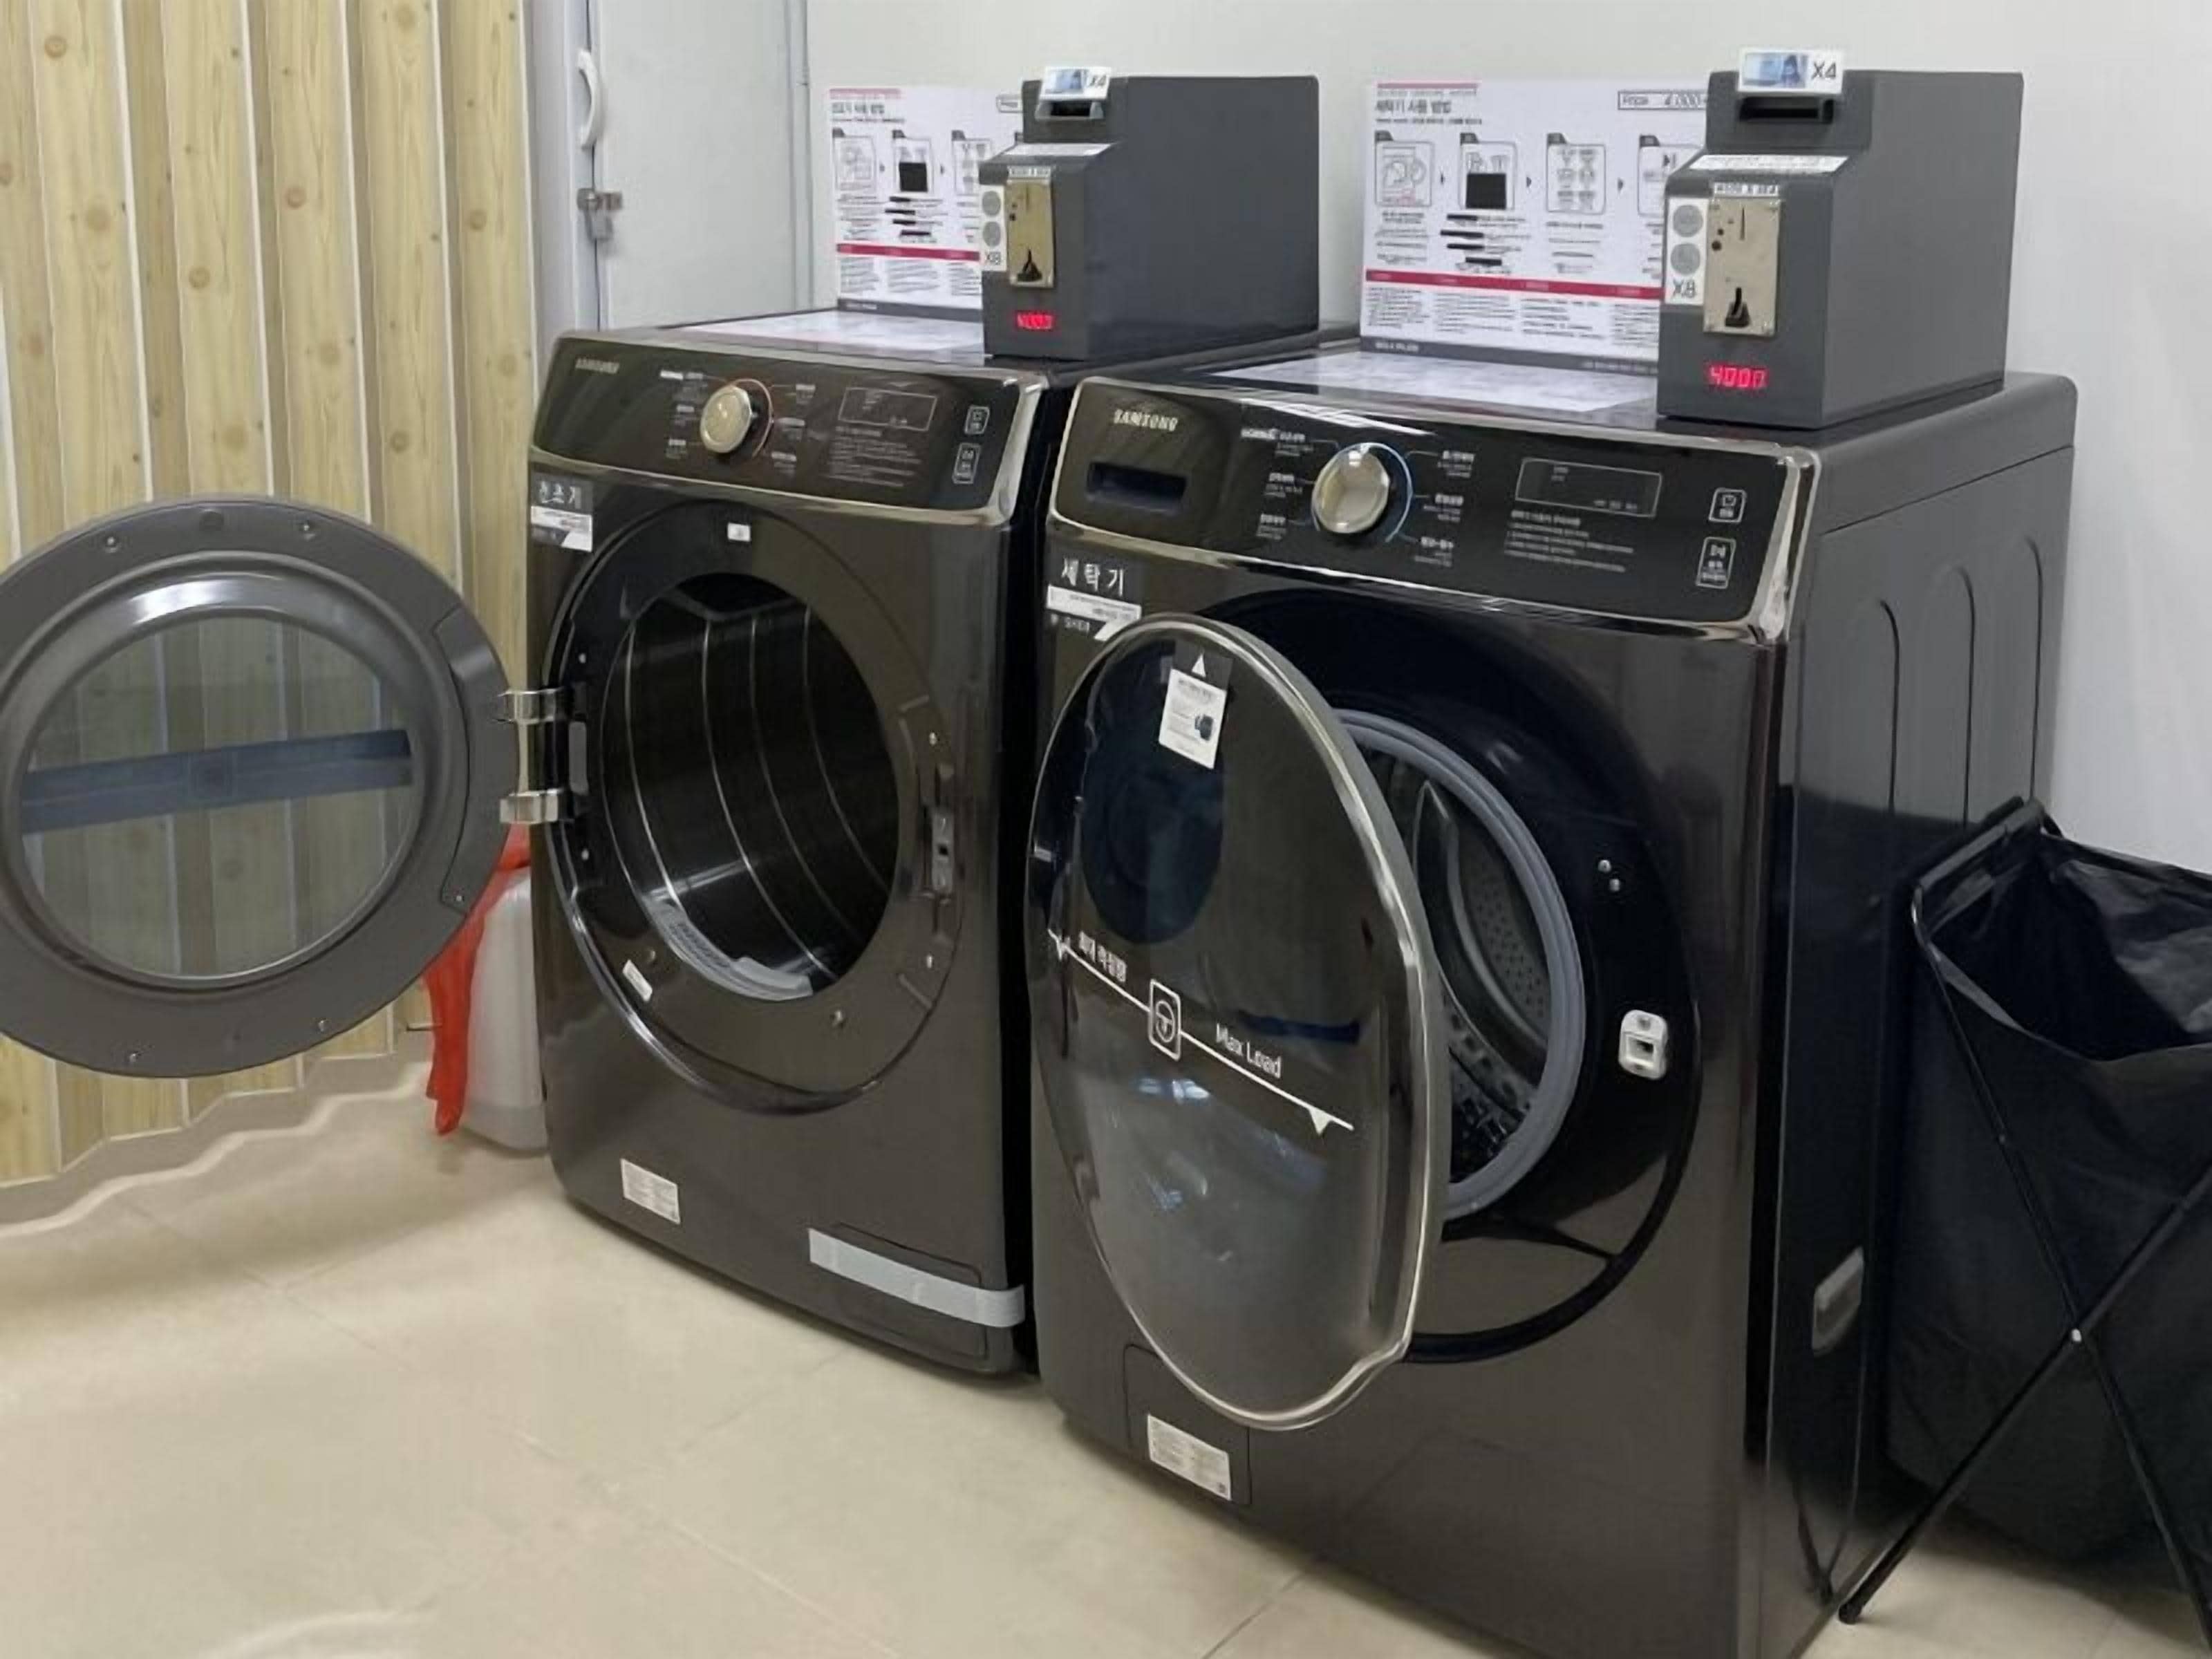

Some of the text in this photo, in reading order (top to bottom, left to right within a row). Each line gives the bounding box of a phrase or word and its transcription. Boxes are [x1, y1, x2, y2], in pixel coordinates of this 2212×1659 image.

[1812, 61, 1837, 80] X4
[1672, 278, 1696, 299] X8
[1709, 365, 1766, 388] 4000
[1114, 409, 1178, 431] SAMSUNG
[1216, 1023, 1281, 1078] Max Load
